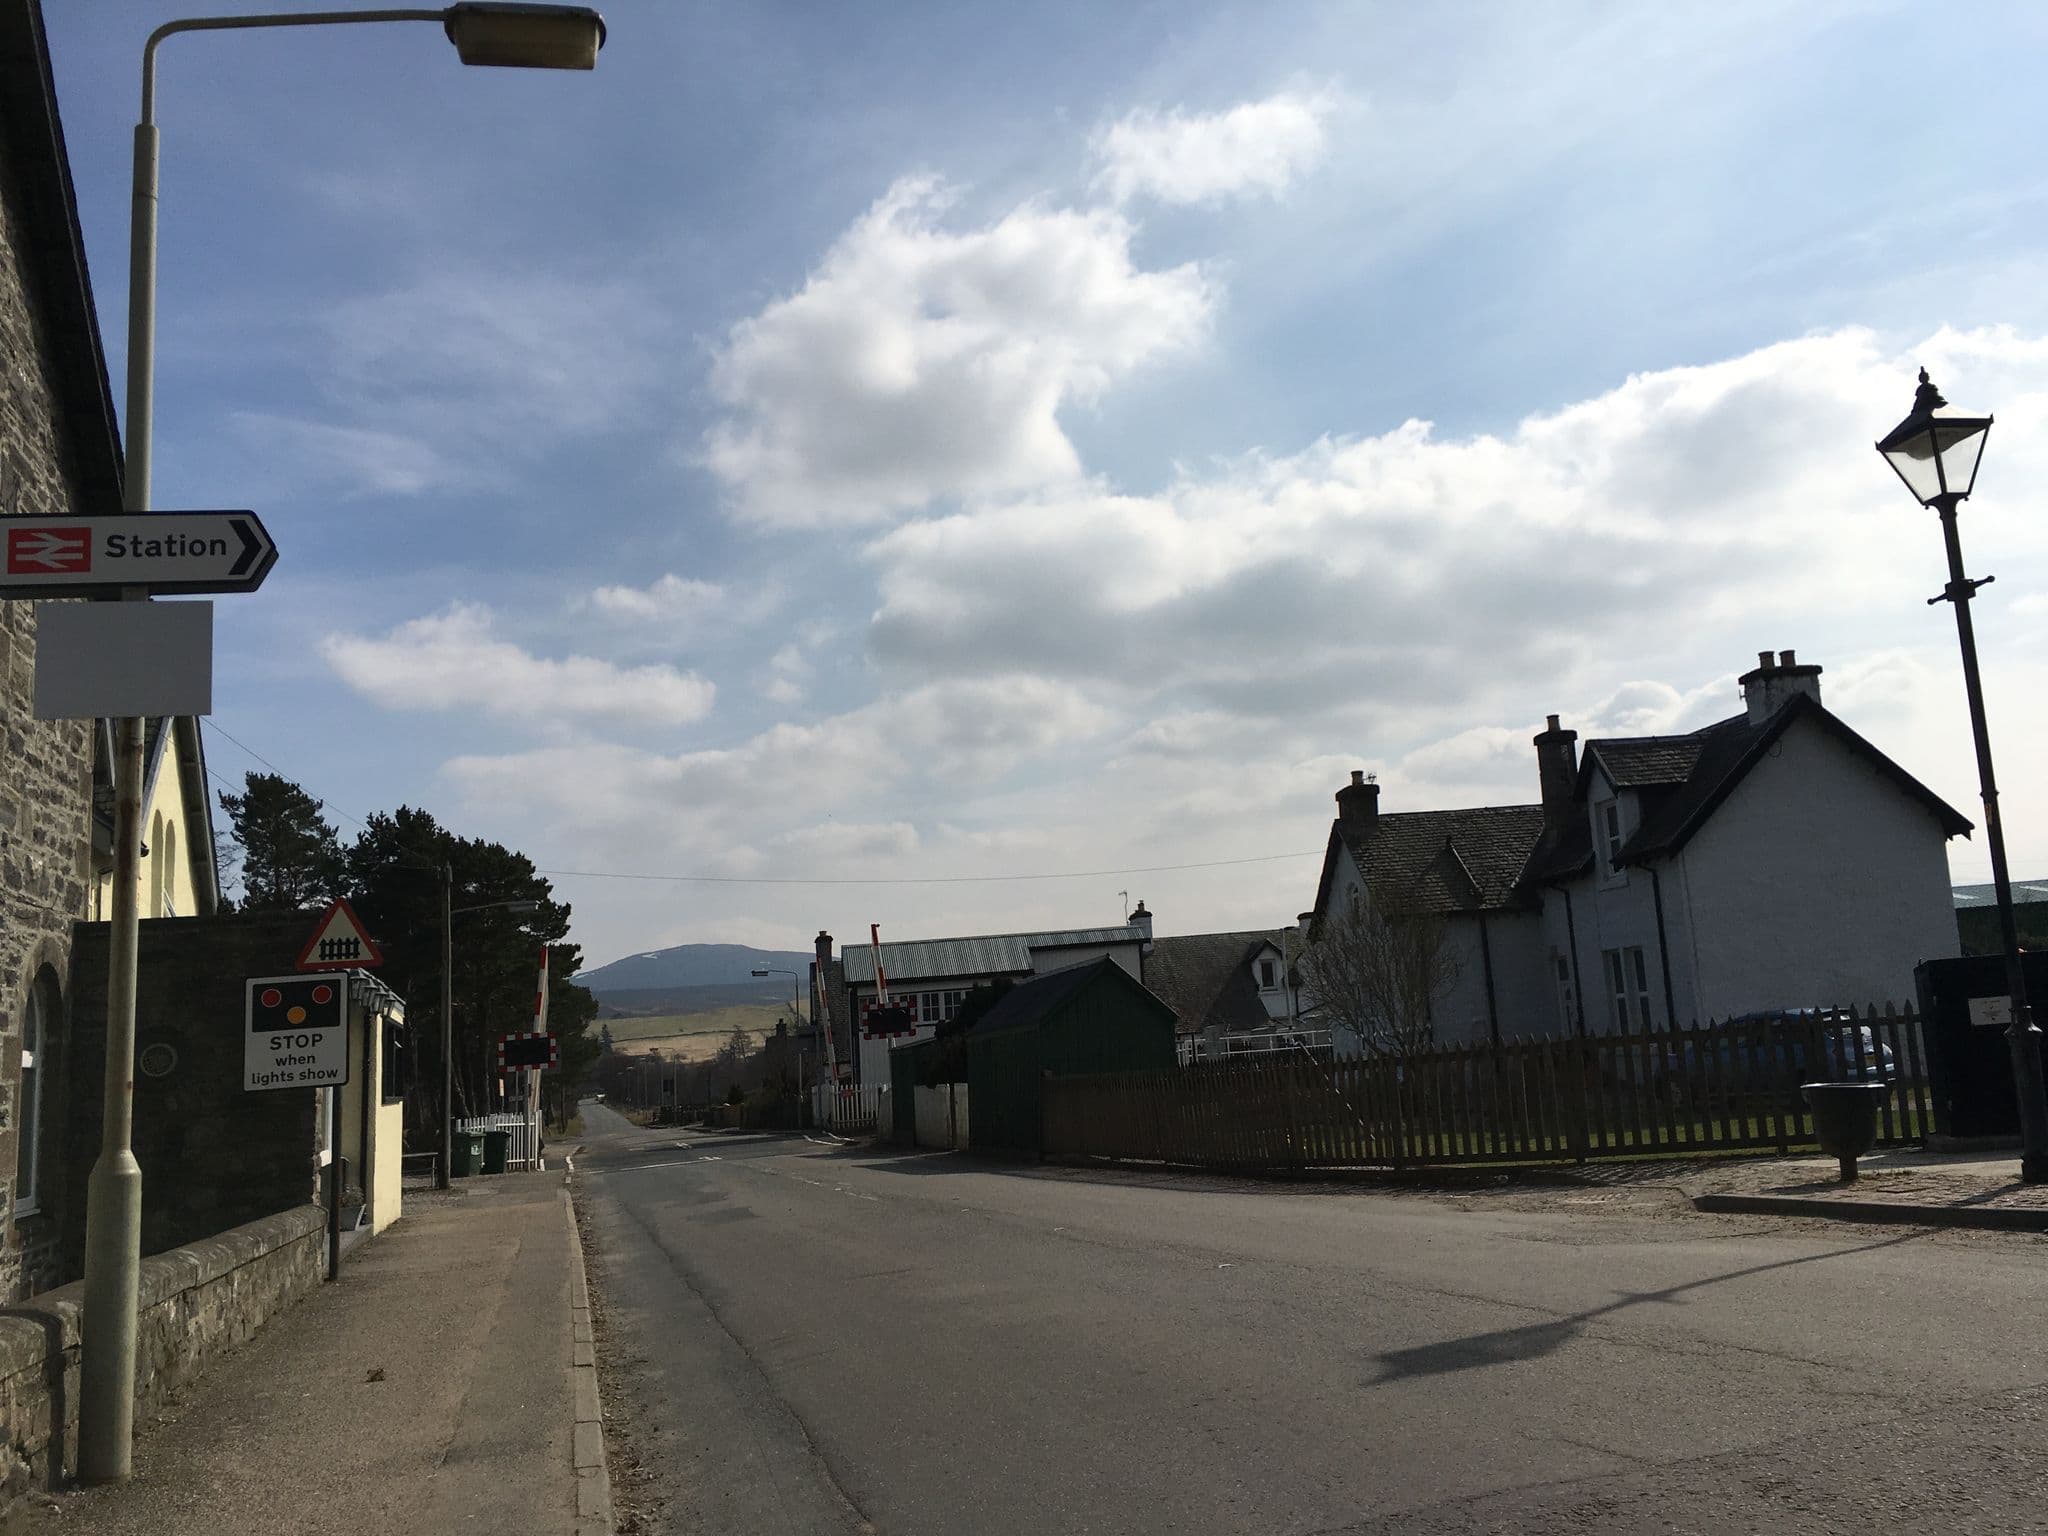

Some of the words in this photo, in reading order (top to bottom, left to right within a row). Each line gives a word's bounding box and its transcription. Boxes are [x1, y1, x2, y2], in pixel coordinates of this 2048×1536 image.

[104, 534, 227, 558] Station
[270, 1034, 323, 1050] STOP
[275, 1053, 316, 1066] when
[252, 1070, 294, 1086] lights
[299, 1068, 338, 1081] show
